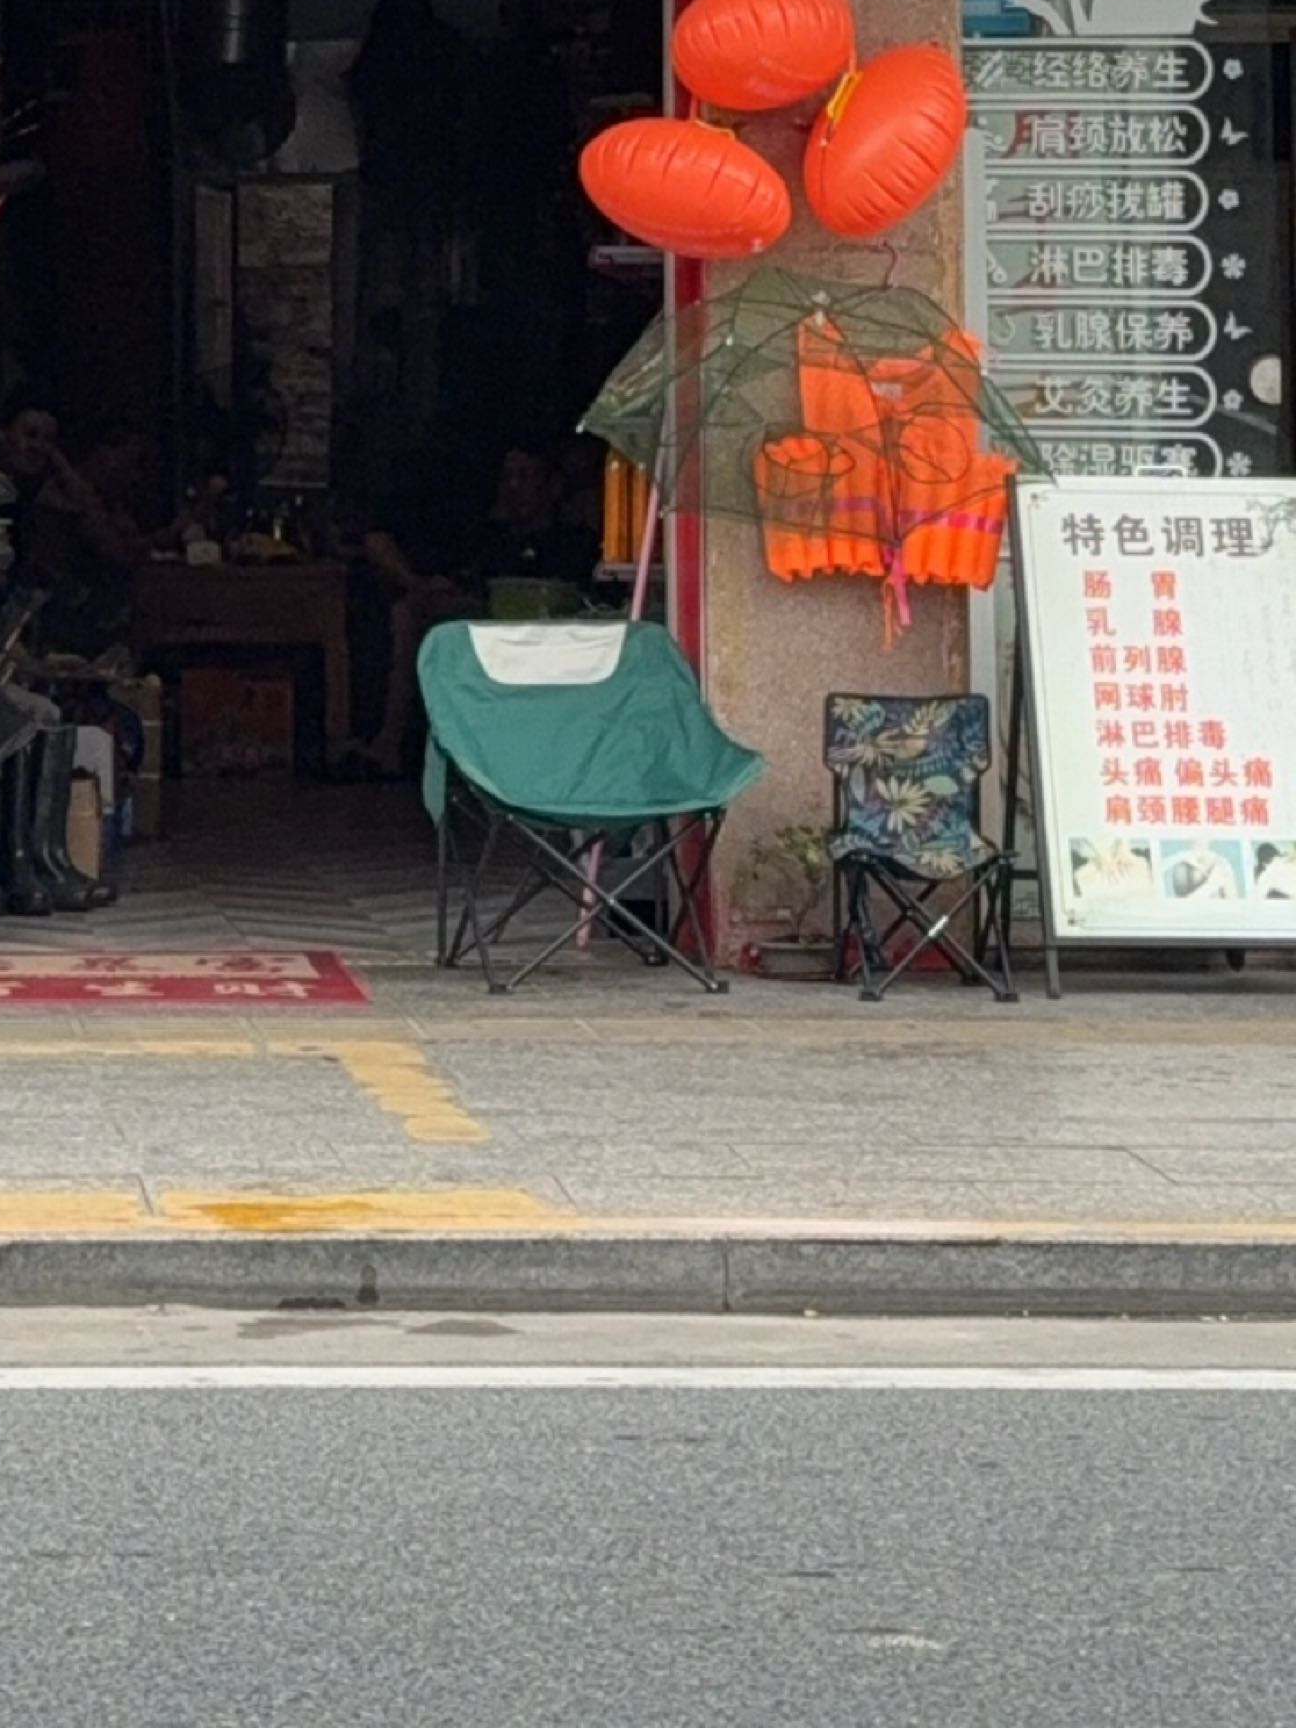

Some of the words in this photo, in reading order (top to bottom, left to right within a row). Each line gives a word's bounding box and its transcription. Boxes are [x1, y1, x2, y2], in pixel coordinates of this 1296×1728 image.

[1033, 52, 1191, 90] 经络养生
[1029, 114, 1189, 155] 肩颈放松
[1027, 181, 1187, 221] 刮痧拔罐
[1030, 246, 1190, 286] 淋巴排毒
[1034, 312, 1194, 352] 乳腺保养
[1033, 378, 1194, 417] 艾灸养生
[1059, 512, 1258, 558] 特色调理
[1088, 644, 1189, 676] 前列腺
[1092, 680, 1190, 714] 网球肘
[1094, 719, 1230, 752] 淋巴排毒
[1104, 793, 1272, 828] 肩颈腰腿痛
